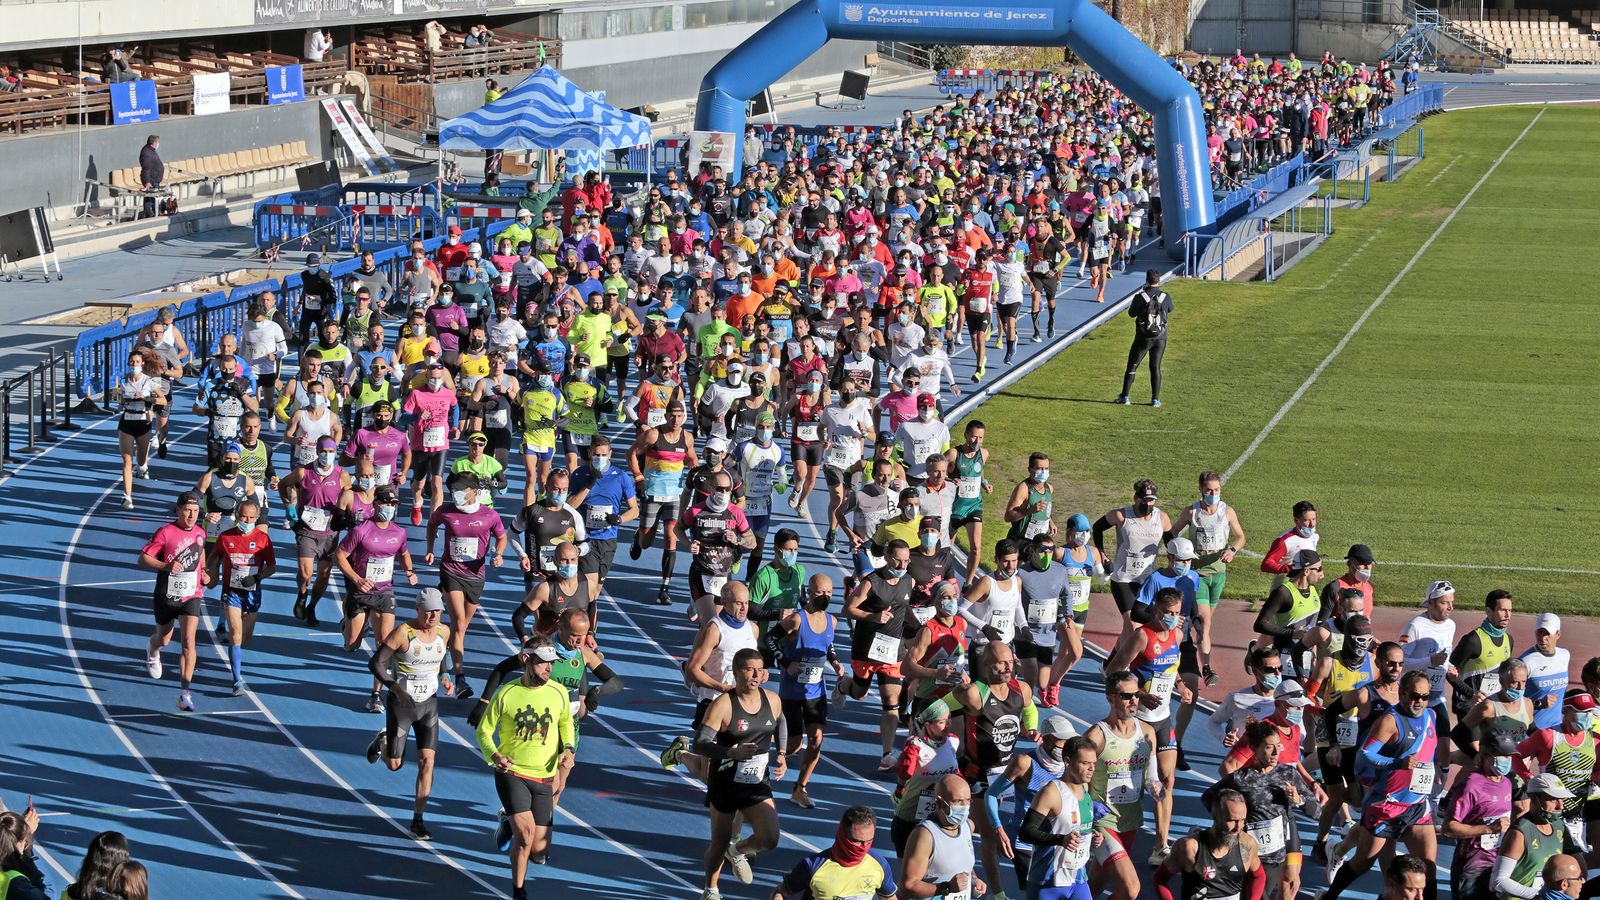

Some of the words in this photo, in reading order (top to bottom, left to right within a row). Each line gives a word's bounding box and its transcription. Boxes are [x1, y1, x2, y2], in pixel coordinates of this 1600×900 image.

[867, 7, 980, 19] Ayuntamiento
[983, 10, 1002, 19] de
[1006, 10, 1047, 20] Jerez
[867, 15, 919, 24] Deportes
[427, 434, 438, 442] 272
[1132, 561, 1145, 570] 452
[372, 567, 386, 575] 789
[174, 581, 187, 589] 653
[1036, 609, 1046, 617] 17
[997, 619, 1009, 628] 817
[413, 685, 428, 694] 732
[1336, 728, 1352, 738] 475
[743, 766, 759, 776] 576
[1121, 784, 1127, 794] 8
[1259, 833, 1272, 844] 13
